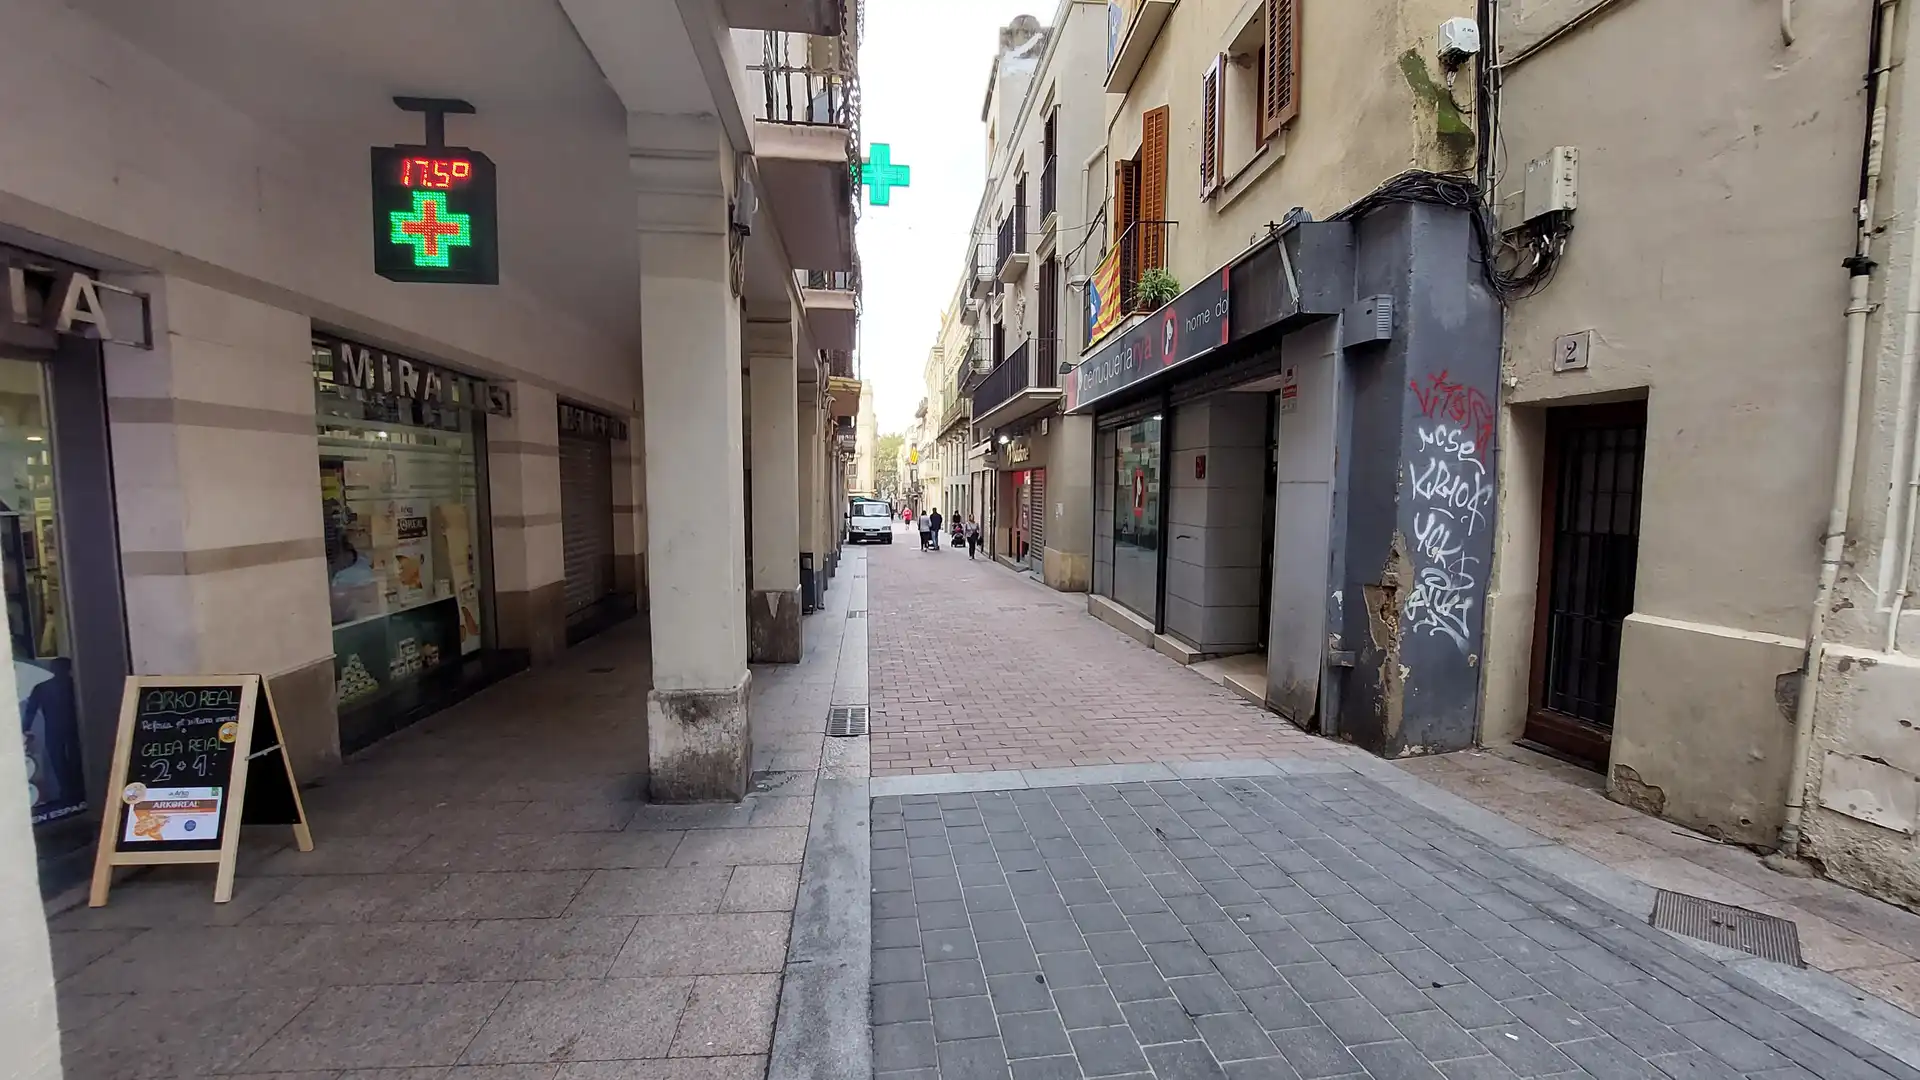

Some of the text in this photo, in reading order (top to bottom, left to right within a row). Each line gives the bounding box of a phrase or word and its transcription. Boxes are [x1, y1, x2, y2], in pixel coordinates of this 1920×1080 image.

[1185, 308, 1211, 334] home
[1565, 340, 1578, 364] 2
[145, 689, 239, 711] ARKO REAL
[141, 736, 228, 757] GELEA REIAL
